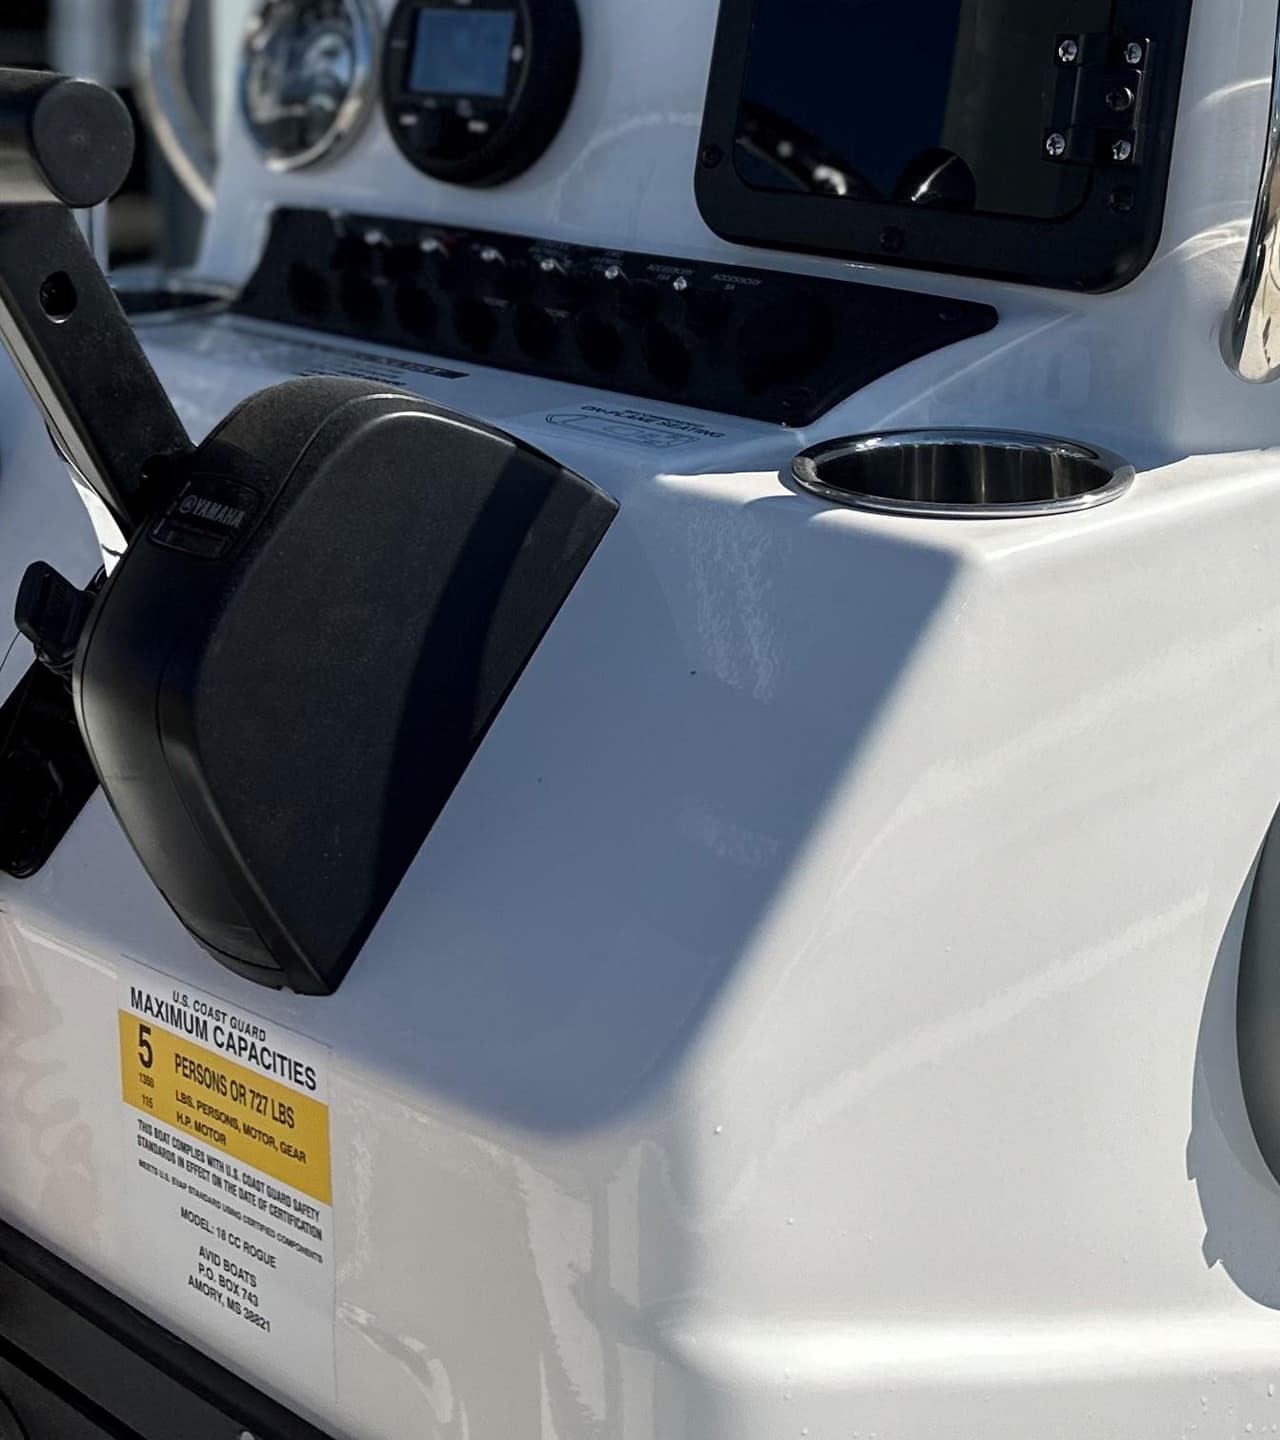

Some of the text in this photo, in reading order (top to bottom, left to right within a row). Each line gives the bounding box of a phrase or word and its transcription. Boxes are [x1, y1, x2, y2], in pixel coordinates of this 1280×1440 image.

[193, 498, 245, 528] YAMAHA
[172, 990, 266, 1041] U.S. COAST GUARD
[130, 986, 317, 1091] MAXIMUM CAPACITIES
[138, 1023, 295, 1129] 5 PERSONS OR 727 LBS
[194, 1120, 227, 1146] MOTOR
[280, 1141, 306, 1164] GEAR
[137, 1118, 320, 1222] THIS BOAT COMPLIES WITH U.S. COAST GUARD SAFETY
[137, 1134, 322, 1241] STANDARDS IN EFFECT ON THE DATE OF CERTIFICATION
[199, 1245, 257, 1288] AVID BOATS
[216, 1227, 226, 1241] 18
[228, 1233, 241, 1249] CC
[243, 1241, 277, 1269] ROGUE
[188, 1274, 225, 1308] AMORY,
[226, 1296, 242, 1315] MS
[198, 1262, 259, 1308] P.O. BOX 743
